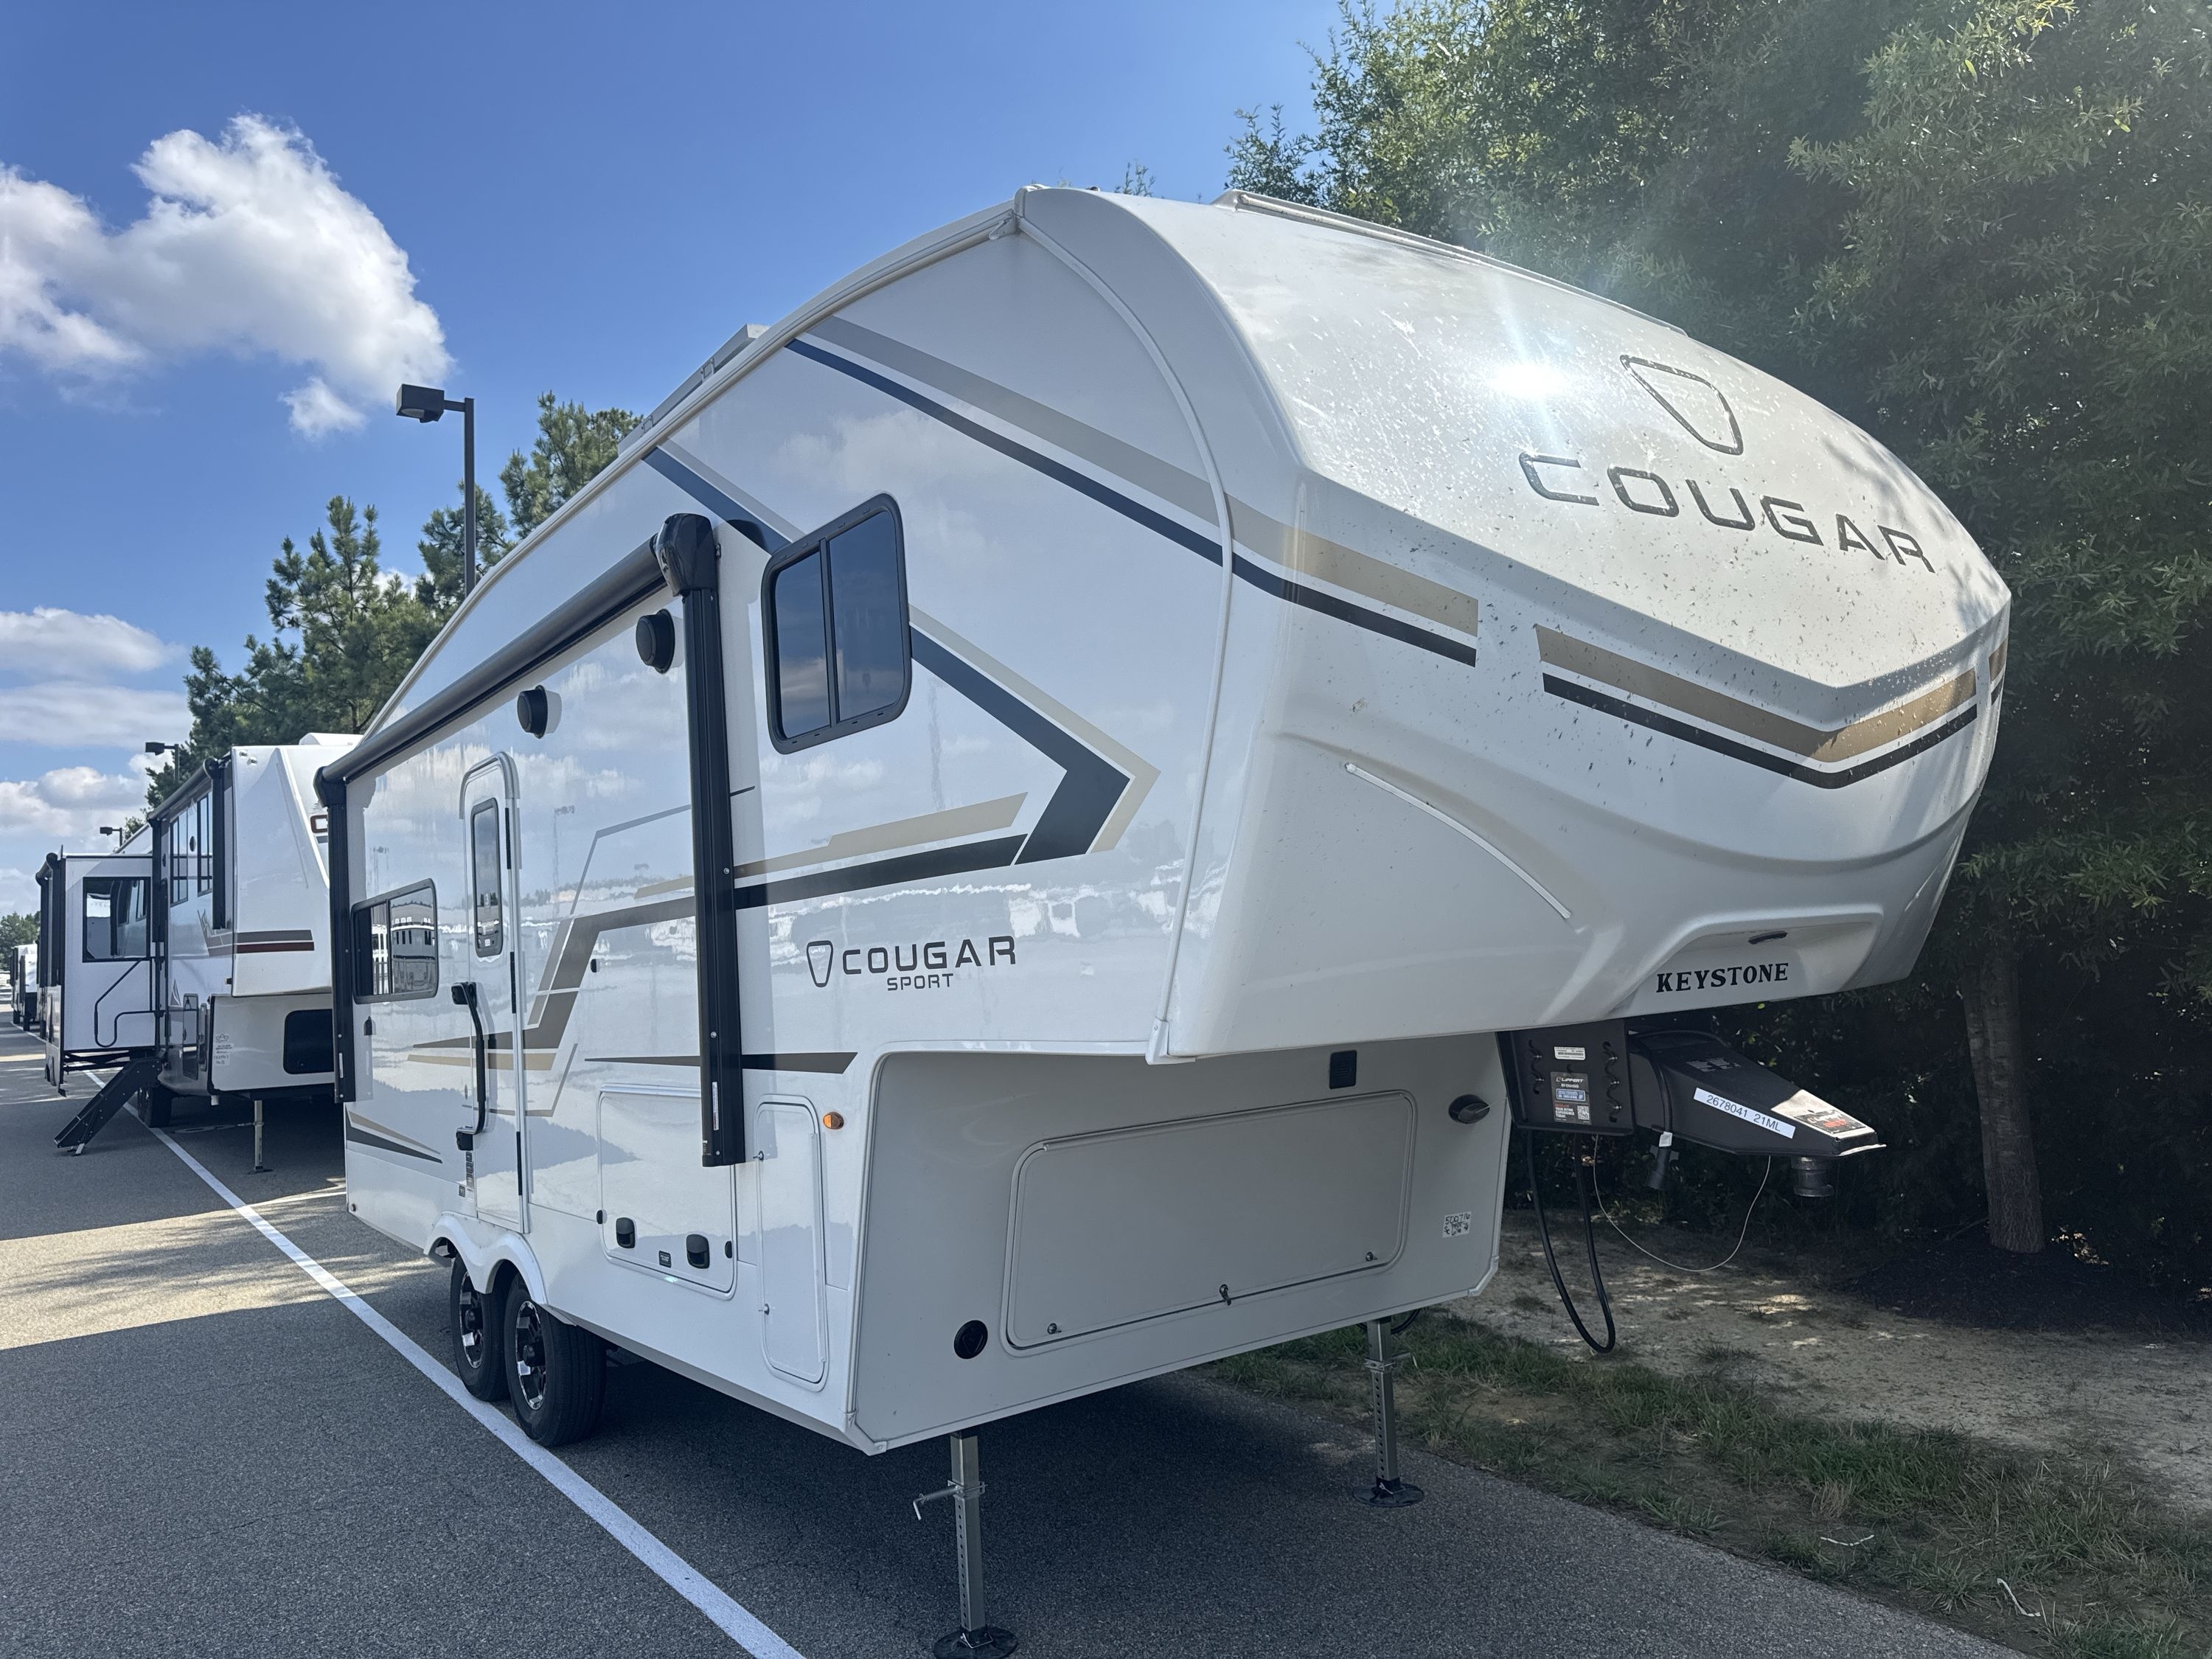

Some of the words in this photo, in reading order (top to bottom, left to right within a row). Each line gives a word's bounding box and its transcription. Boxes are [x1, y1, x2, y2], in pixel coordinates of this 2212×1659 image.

[1518, 451, 1935, 574] COUGAR
[842, 935, 1016, 975] COUGAR
[887, 973, 953, 992] SPORT
[1656, 962, 1789, 993] KEYSTONE
[1706, 1094, 1748, 1118] 2678041
[1753, 1113, 1781, 1132] 21ML
